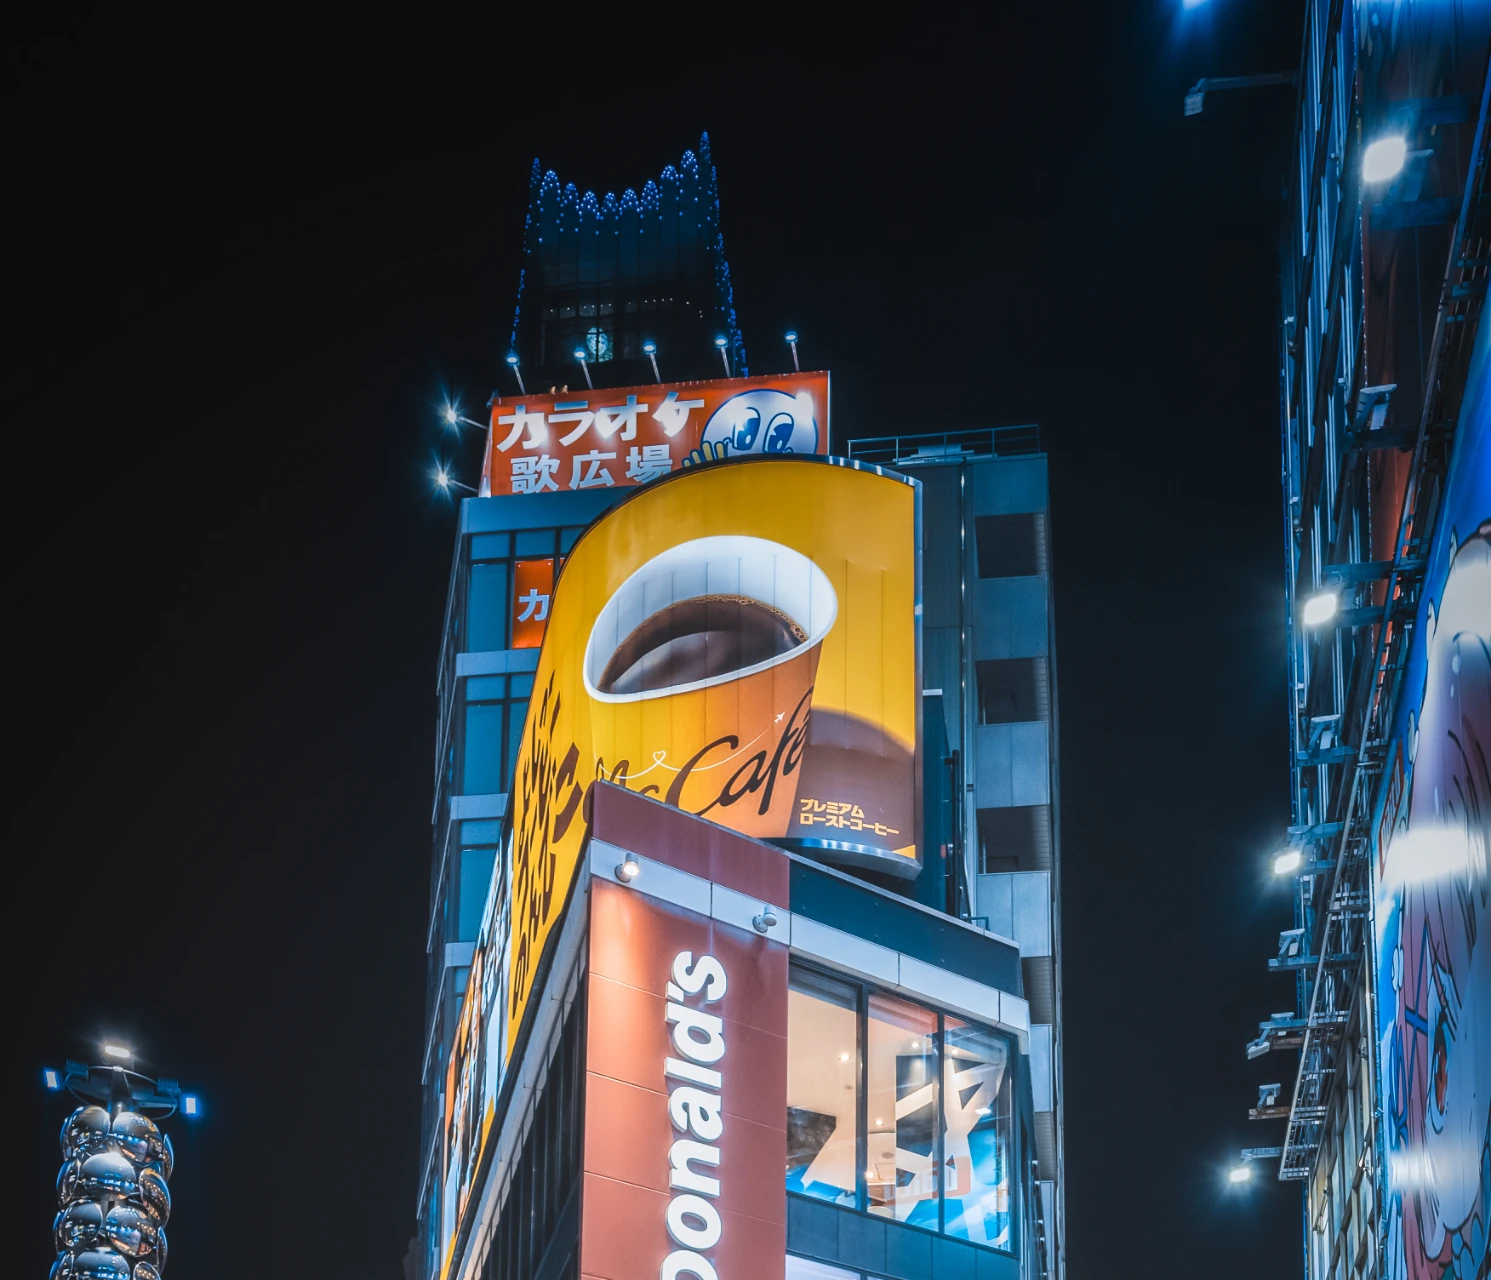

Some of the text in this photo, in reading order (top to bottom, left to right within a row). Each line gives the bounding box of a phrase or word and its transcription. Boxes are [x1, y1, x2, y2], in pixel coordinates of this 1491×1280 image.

[496, 391, 705, 452] カラオケ
[510, 443, 673, 494] 歌広場
[800, 799, 865, 819] プレミアム
[800, 812, 899, 836] ローストコーヒー
